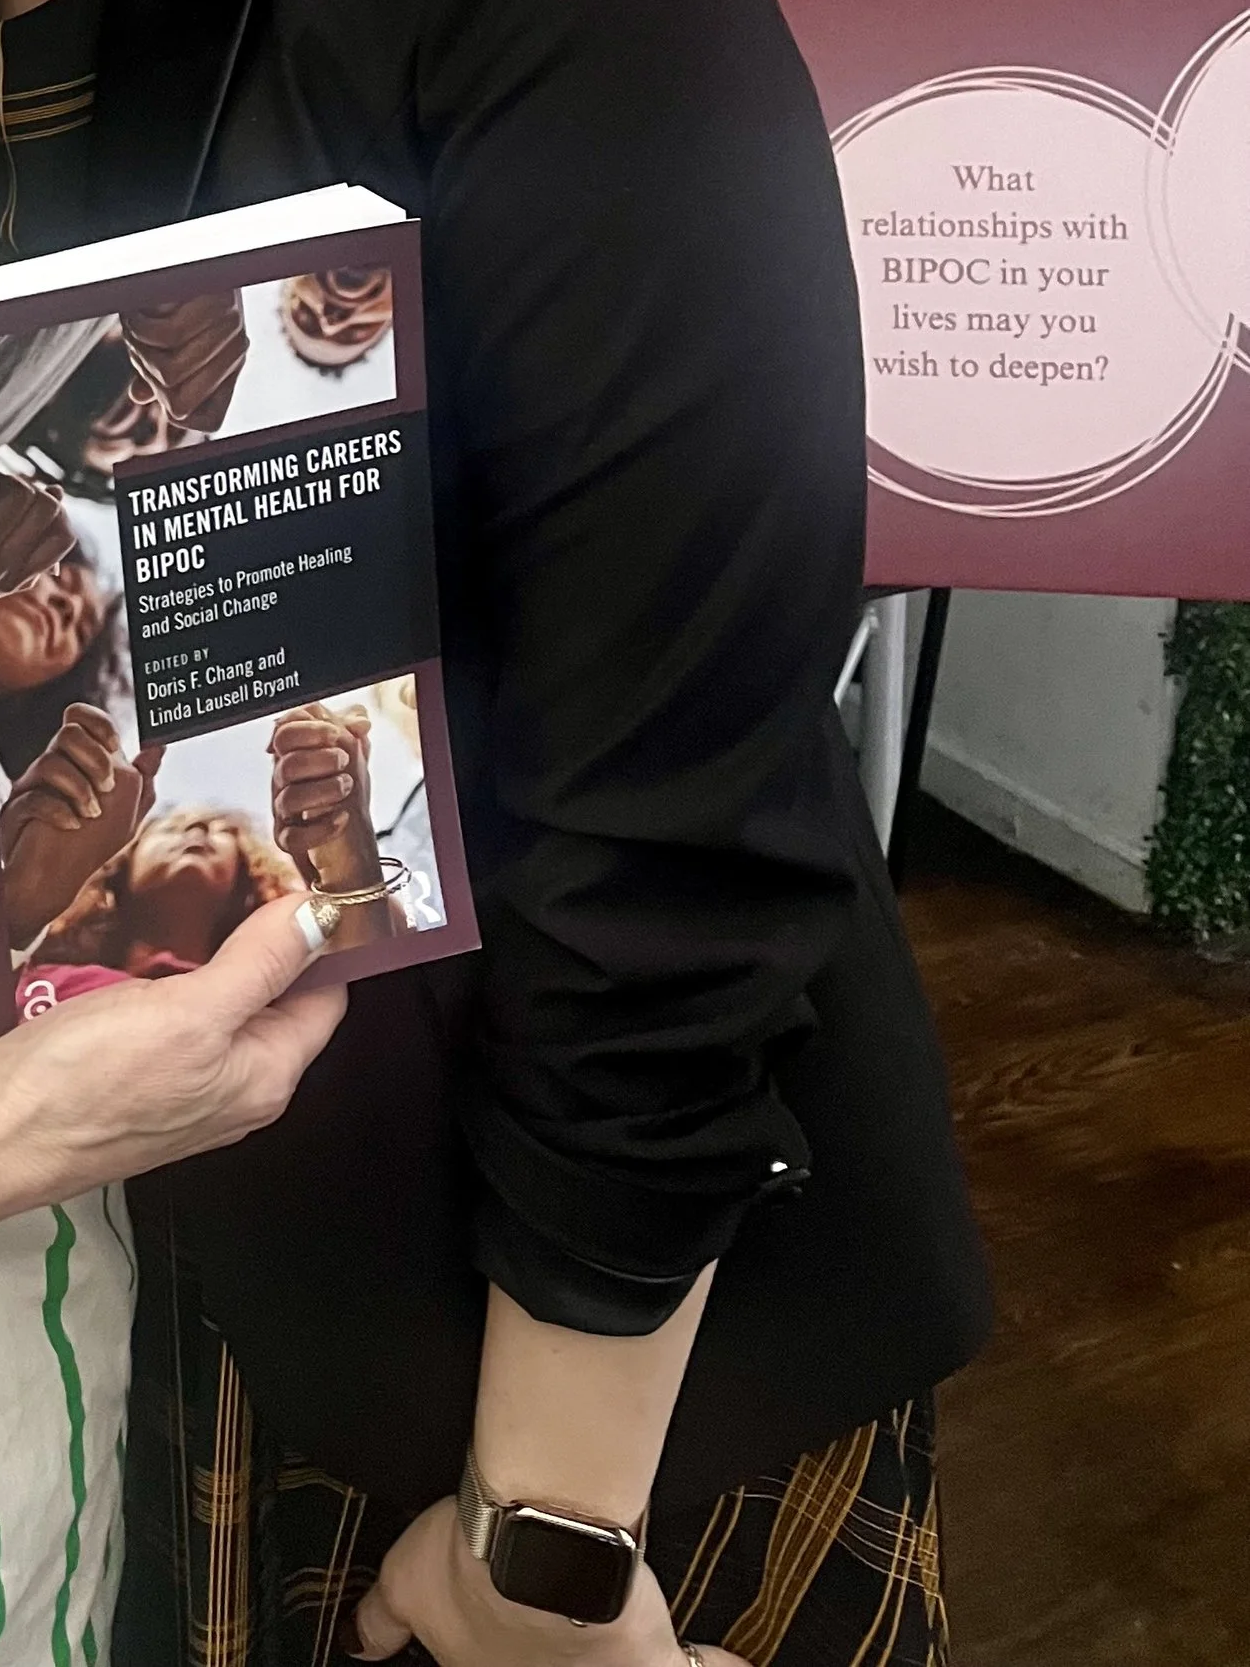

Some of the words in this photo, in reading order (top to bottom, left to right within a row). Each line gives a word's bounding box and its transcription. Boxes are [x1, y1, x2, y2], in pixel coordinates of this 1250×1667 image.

[951, 164, 1035, 193] What
[861, 211, 1052, 245] relationships
[1063, 215, 1129, 241] with
[881, 257, 992, 285] BIPOC
[999, 259, 1028, 286] in
[1038, 264, 1110, 292] your
[892, 304, 957, 332] lives
[967, 311, 1030, 338] may
[1041, 312, 1097, 338] you
[873, 349, 939, 378] wish
[950, 353, 979, 378] to
[989, 354, 1109, 386] deepen?
[128, 454, 299, 517] TRANSFORMING
[306, 429, 402, 474] CAREERS
[133, 524, 157, 550] IN
[164, 500, 248, 543] MENTAL
[254, 479, 332, 521] HEALTH
[339, 467, 381, 499] FOR
[136, 544, 206, 584] BIPOC
[138, 582, 215, 614] Strategies
[218, 577, 233, 594] to
[236, 561, 295, 589] Promote
[298, 546, 353, 572] Healing
[142, 616, 170, 639] and
[174, 604, 219, 631] Social
[223, 590, 278, 618] Change
[145, 653, 189, 675] EDITED
[193, 647, 210, 661] BY
[147, 677, 187, 701] Doris
[190, 670, 202, 690] F.
[205, 660, 254, 685] Chang
[258, 647, 286, 670] and
[150, 703, 192, 727] Linda
[196, 683, 249, 715] Lausell
[253, 670, 300, 699] Bryant
